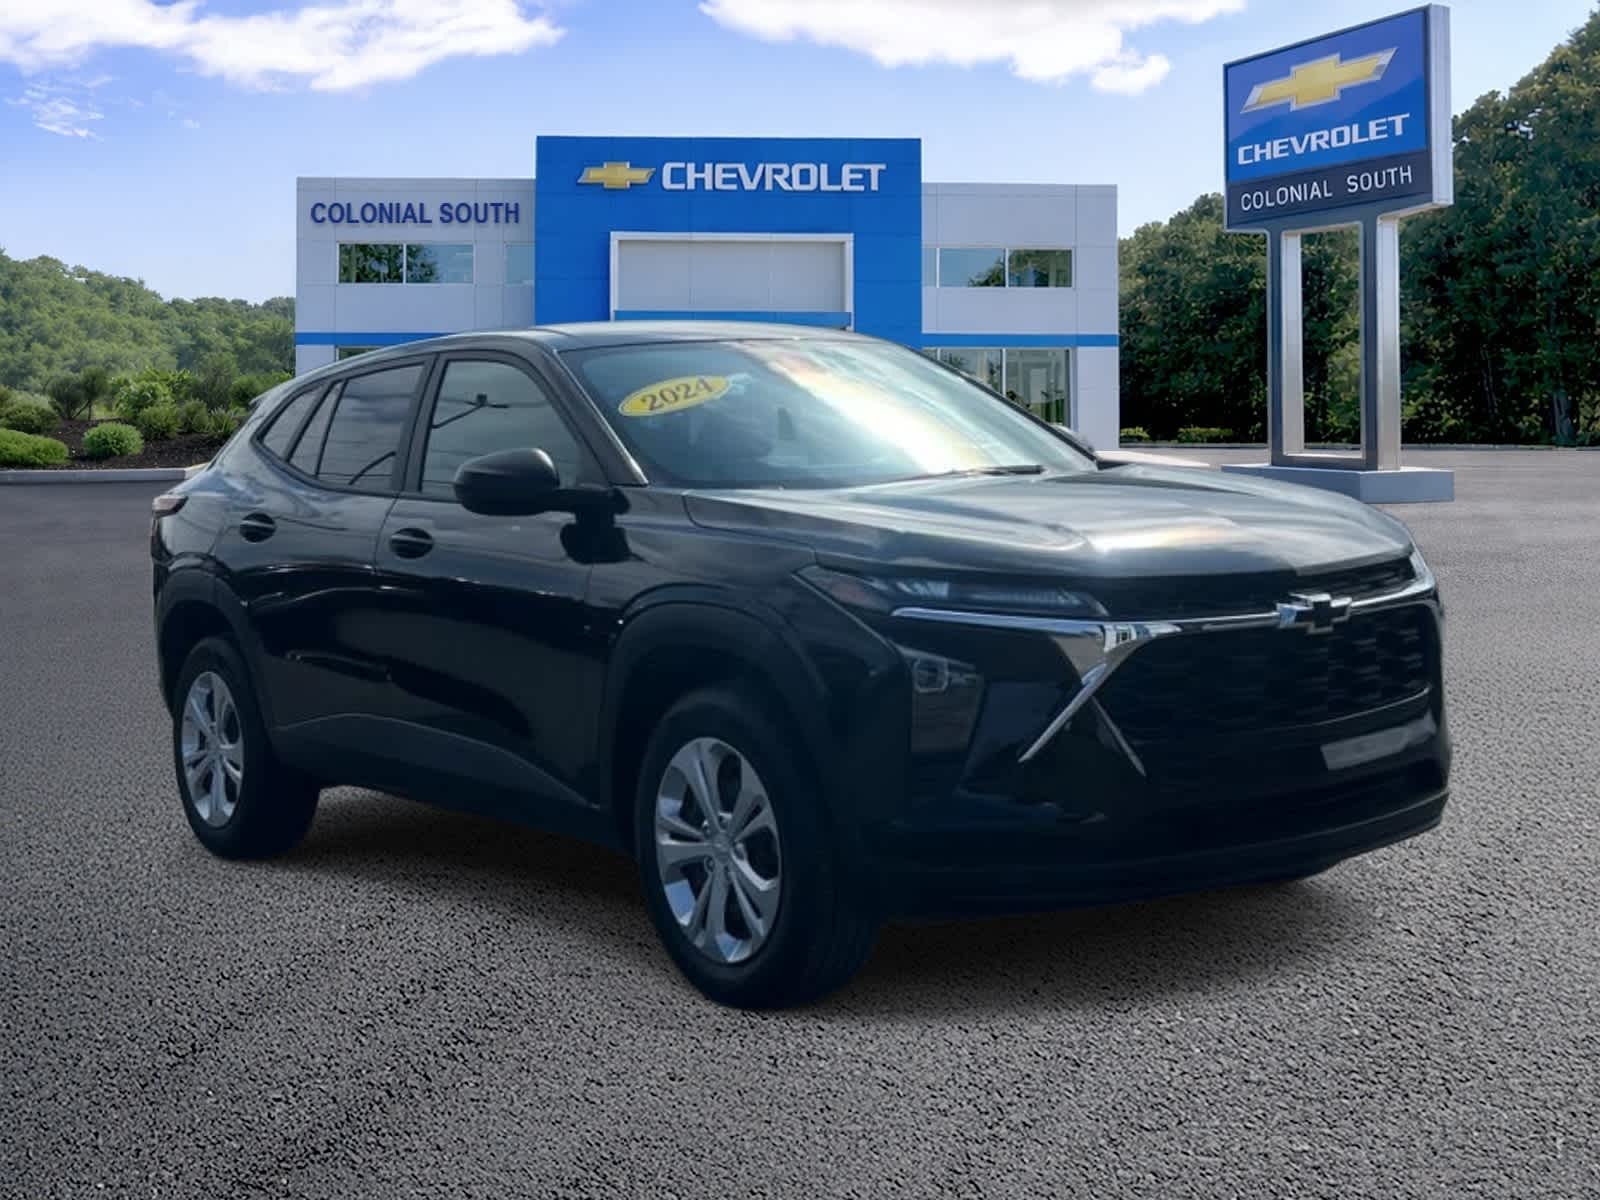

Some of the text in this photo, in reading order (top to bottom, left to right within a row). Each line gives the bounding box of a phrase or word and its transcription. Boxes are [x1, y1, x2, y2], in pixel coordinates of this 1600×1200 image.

[1238, 113, 1410, 165] CHEVROLET
[661, 162, 887, 192] CHEVROLET
[1241, 165, 1413, 211] COLONIAL SOUTH
[310, 202, 520, 225] COLONIAL SOUTH
[640, 378, 713, 411] 2024
